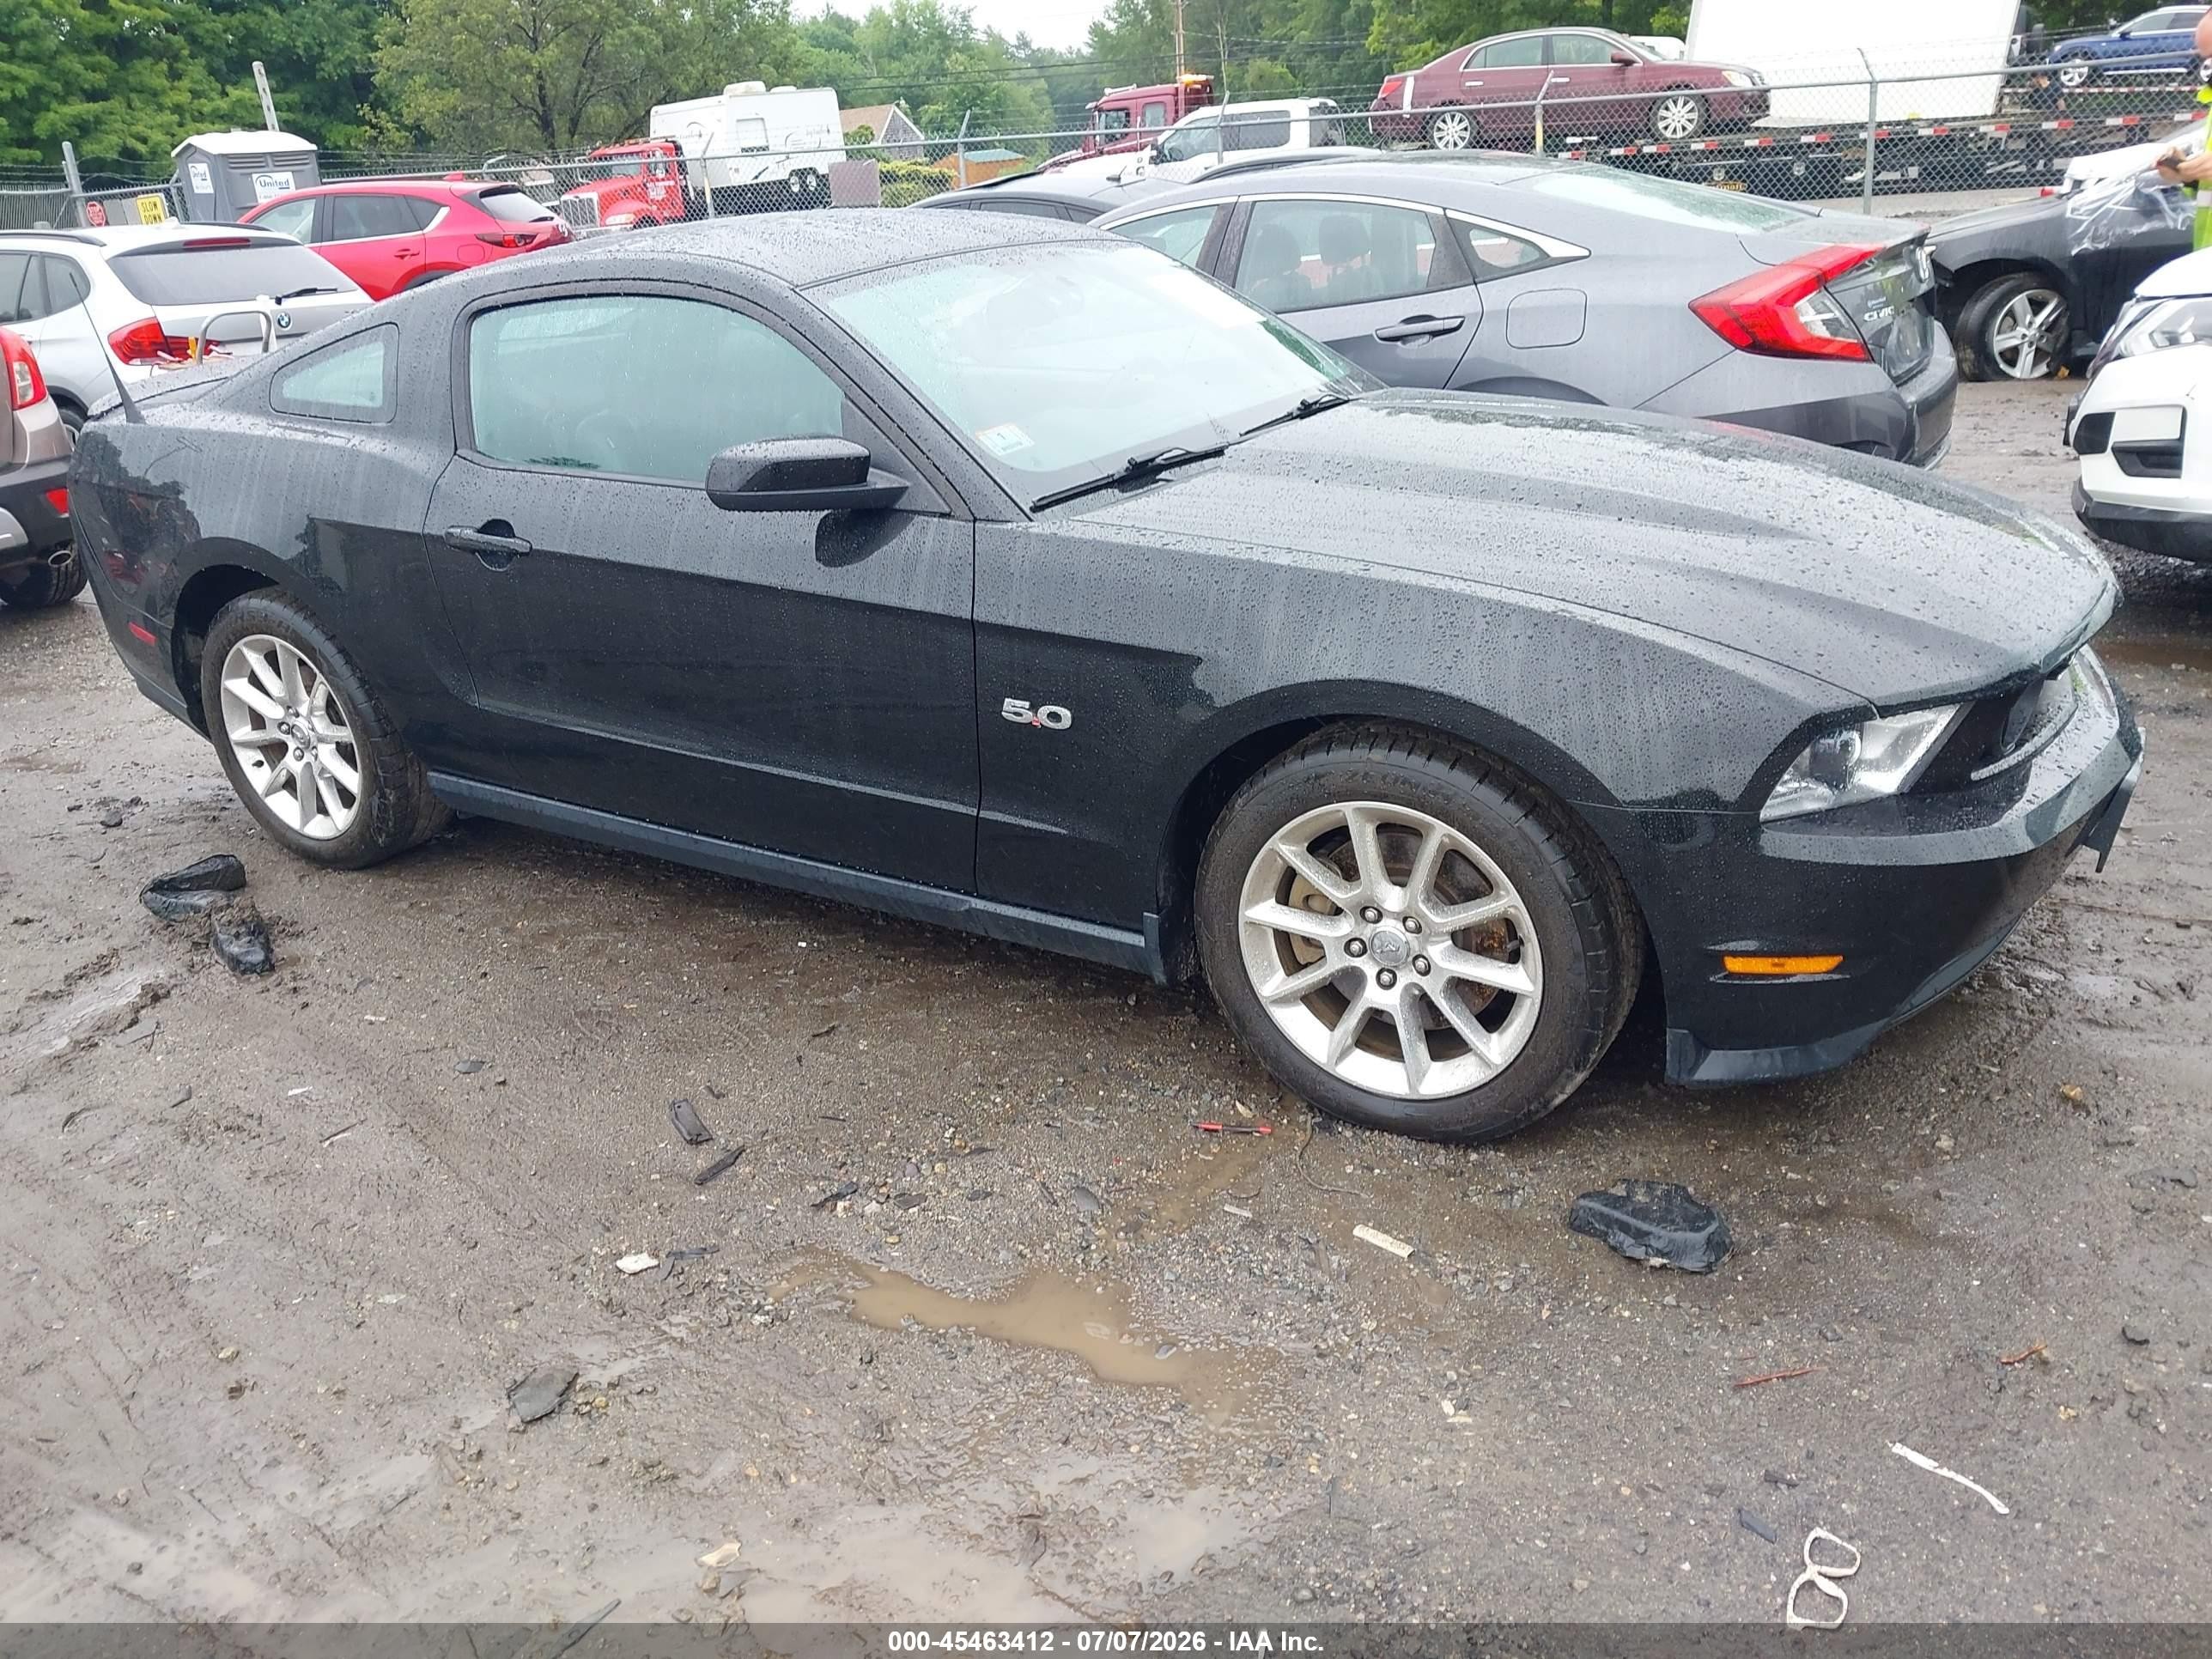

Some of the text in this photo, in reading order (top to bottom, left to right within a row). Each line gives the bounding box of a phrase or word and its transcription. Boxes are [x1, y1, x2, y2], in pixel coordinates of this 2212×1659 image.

[259, 179, 290, 187] United
[141, 200, 158, 212] SLOW
[144, 213, 162, 224] DOWN
[1001, 697, 1073, 730] 5.0
